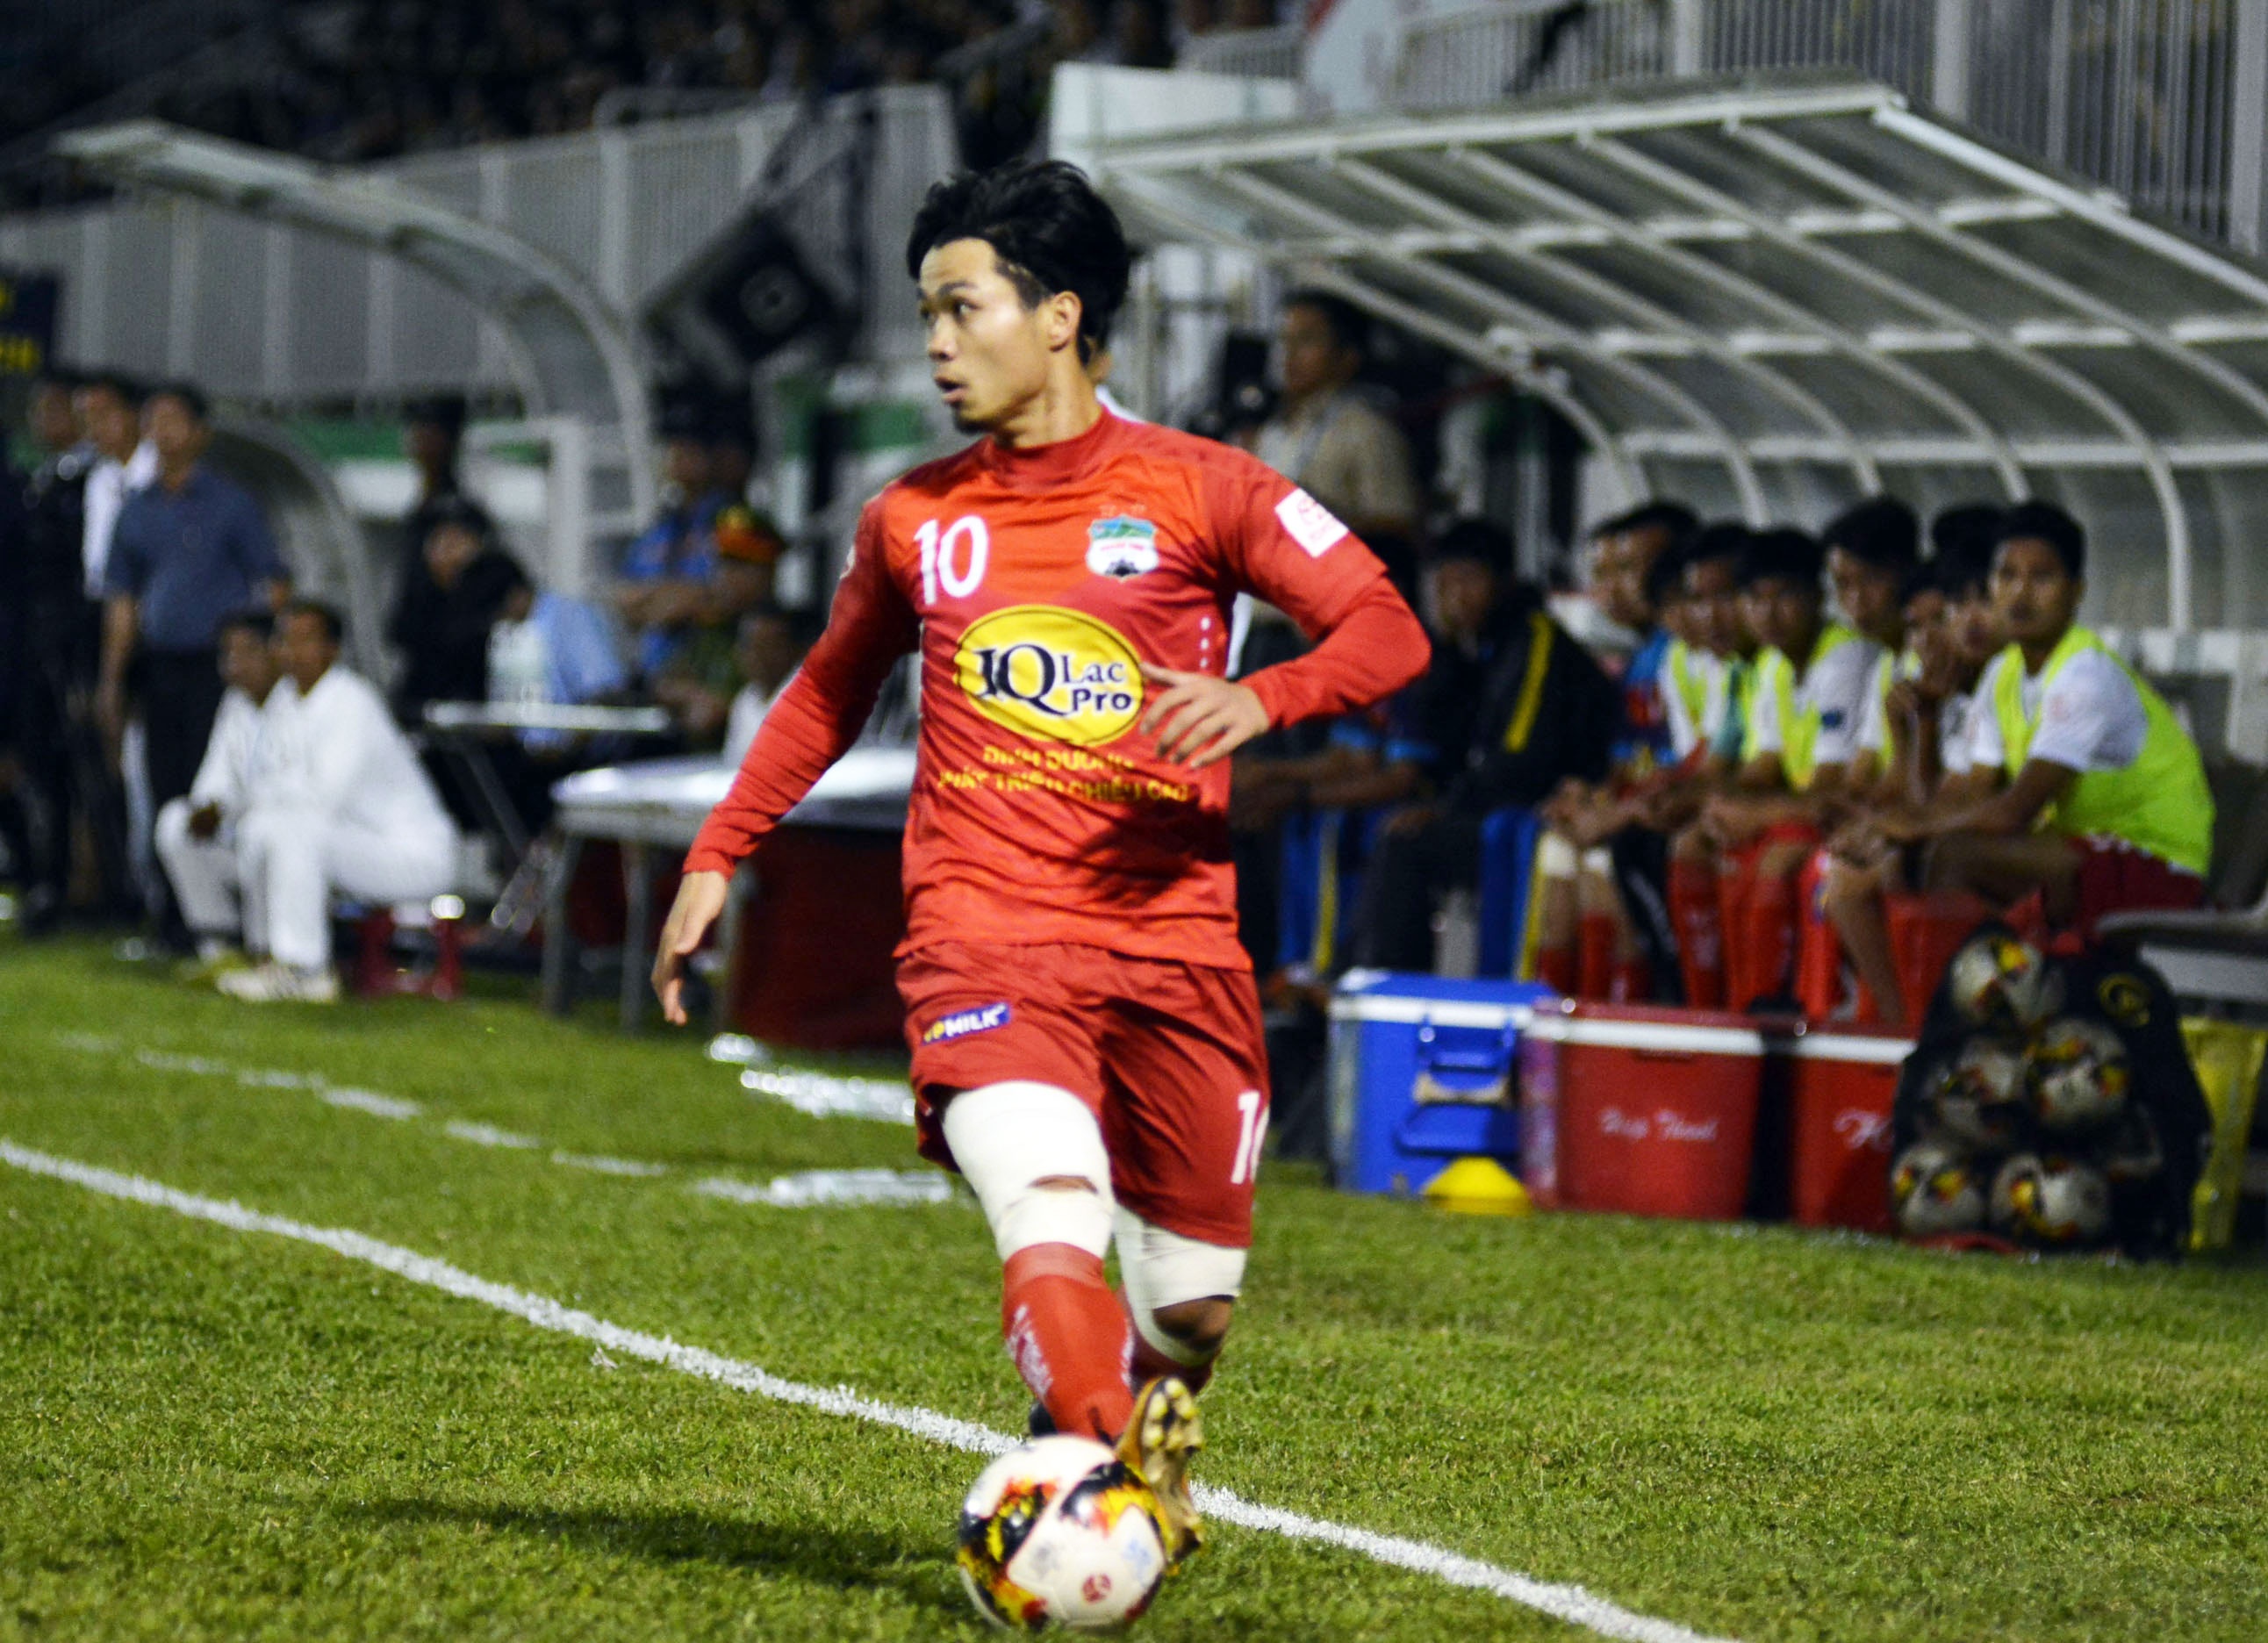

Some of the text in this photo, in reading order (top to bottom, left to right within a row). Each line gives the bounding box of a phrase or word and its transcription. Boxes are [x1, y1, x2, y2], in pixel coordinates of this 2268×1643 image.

[913, 515, 989, 605] 10
[973, 643, 1123, 715] IQ Lac
[1073, 688, 1132, 712] Pro
